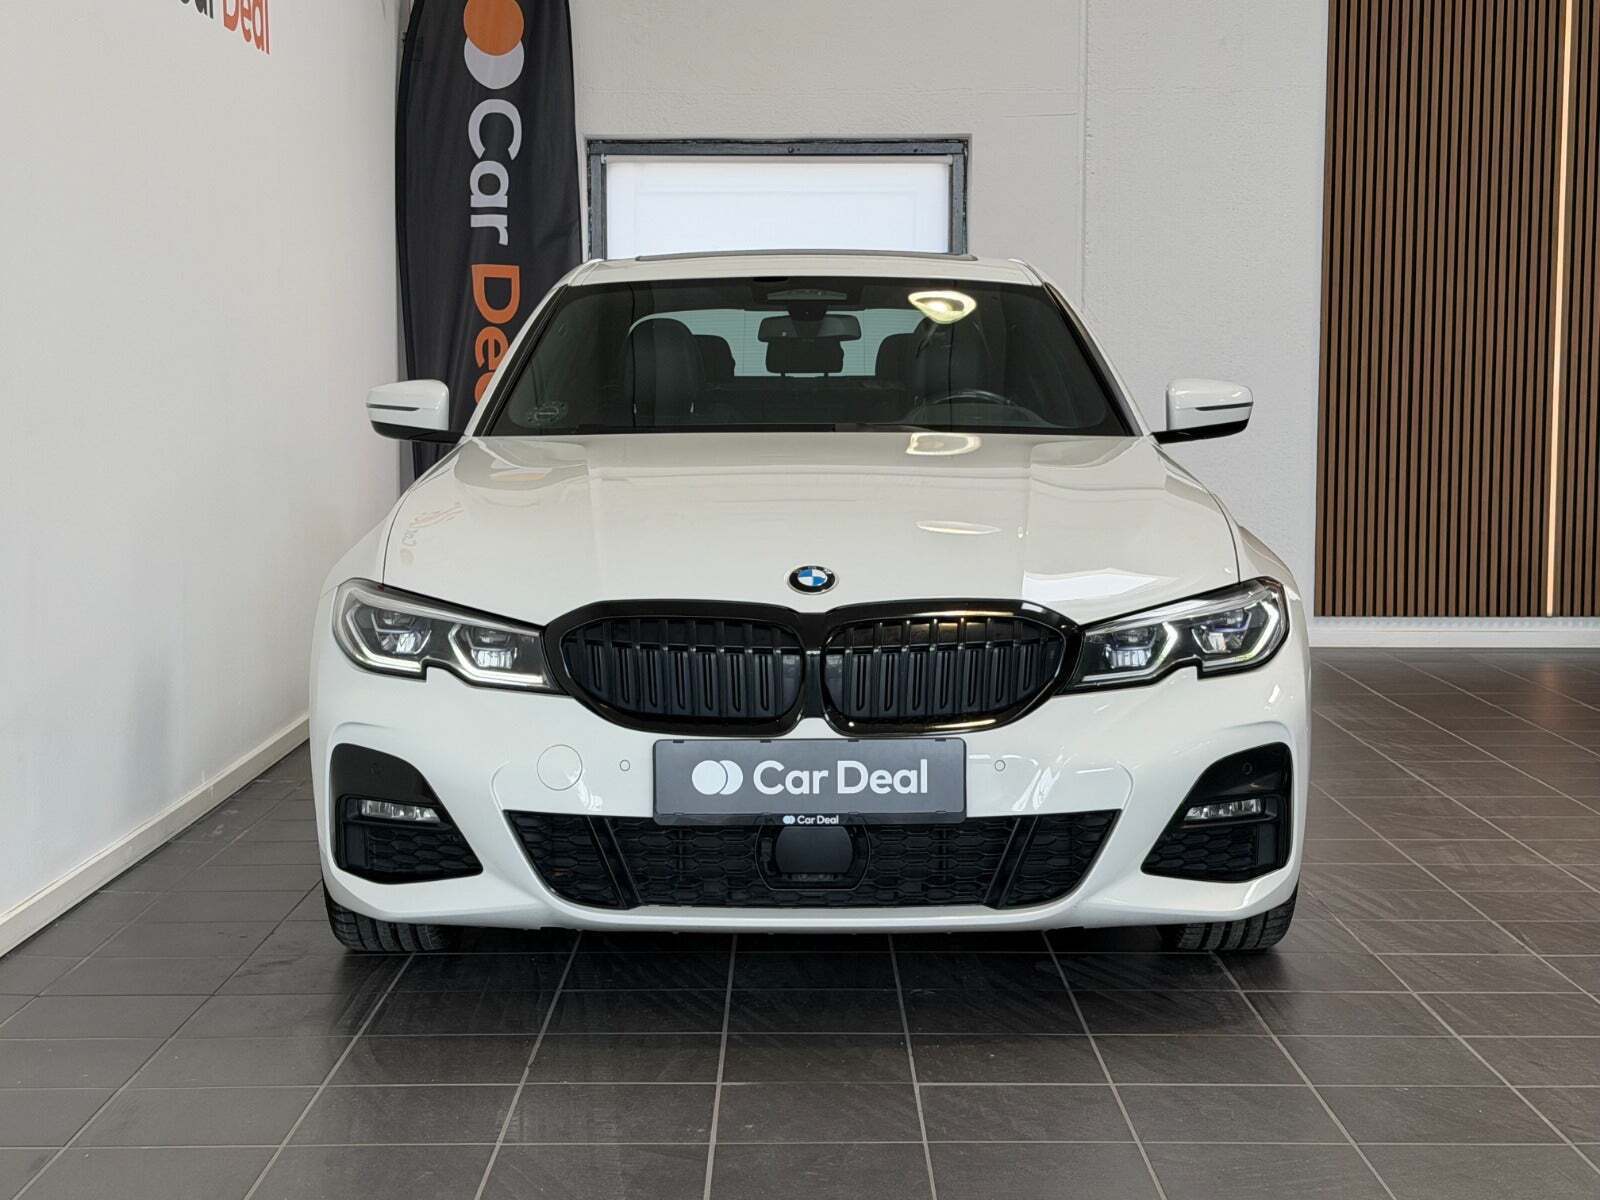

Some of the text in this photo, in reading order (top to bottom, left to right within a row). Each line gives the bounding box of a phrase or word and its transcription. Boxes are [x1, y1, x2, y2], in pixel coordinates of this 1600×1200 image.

[468, 99, 522, 404] Car De
[753, 759, 928, 795] Car Deal
[797, 815, 840, 825] Car Deal
